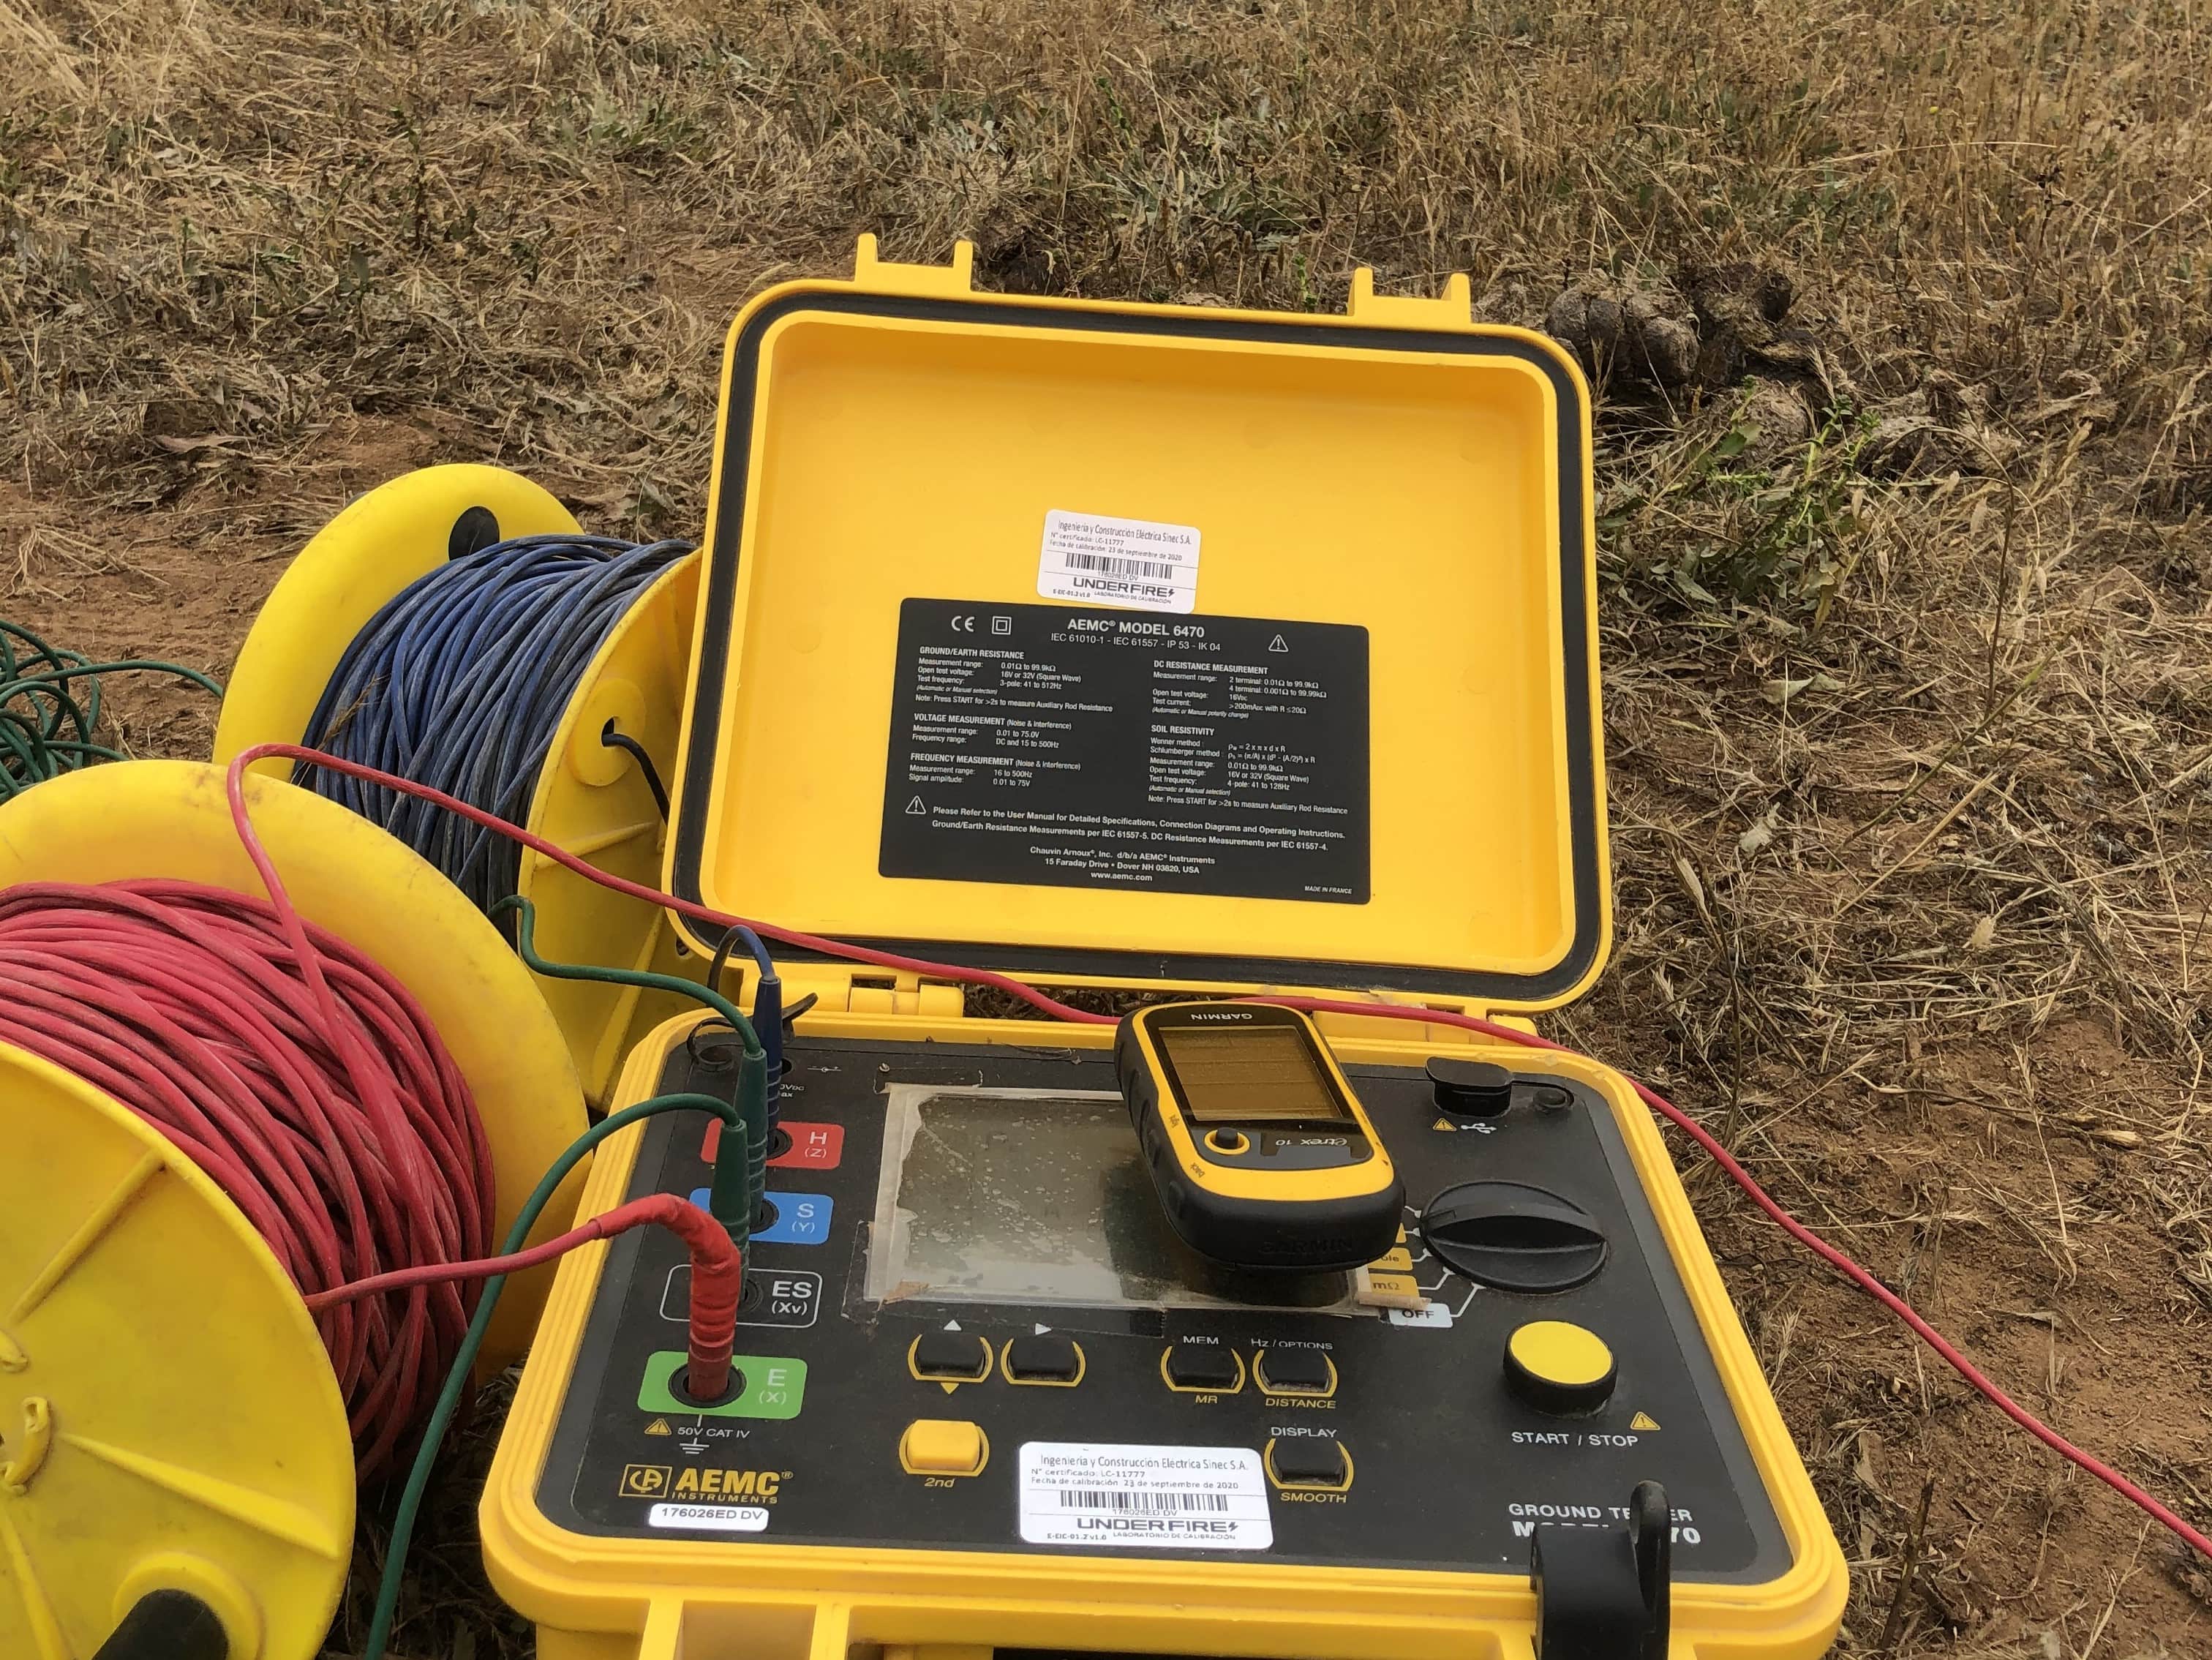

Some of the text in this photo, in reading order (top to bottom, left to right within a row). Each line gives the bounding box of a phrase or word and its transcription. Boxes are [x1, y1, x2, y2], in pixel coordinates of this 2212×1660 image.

[1119, 622, 1170, 636] MODEL
[1173, 625, 1204, 638] 6470
[1051, 633, 1220, 651] IEC 61010-1 IEC 61557 IP 53 IK 04
[919, 646, 1024, 659] GROUND/EARTH RESISTANCE
[1166, 661, 1211, 671] RESISTANCE
[1213, 664, 1268, 675] MEASUREMENT
[914, 713, 947, 722] VOLTAGE
[948, 715, 1005, 725] MEASUREMENT
[1007, 719, 1026, 727] (Noise
[1034, 721, 1072, 730] Interference)
[1151, 724, 1214, 736] SOIL RESISTIVITY
[910, 753, 955, 762] FREQUENCY
[957, 755, 1014, 765] MEASUREMENT
[1015, 759, 1034, 767] (Noise
[1042, 761, 1080, 771] Interference)
[933, 806, 958, 815] Please
[960, 808, 982, 816] Refer
[993, 810, 1005, 818] the
[1007, 811, 1026, 819] User
[1027, 811, 1055, 820] Manual
[1069, 814, 1100, 823] Detailed
[1102, 816, 1157, 827] Specifications,
[1159, 819, 1203, 830] Connection
[1205, 822, 1241, 833] Diagrams
[1259, 825, 1296, 837] Operating
[1298, 828, 1345, 838] Instructions.
[932, 819, 983, 830] Ground/Earth
[985, 822, 1028, 833] Resistance
[1029, 825, 1086, 835] Measurements
[1102, 830, 1116, 838] IEC
[1117, 830, 1148, 840] 61557-5.
[1165, 833, 1207, 843] Resistance
[1208, 835, 1265, 846] Measurements
[1281, 841, 1295, 849] IEC
[1296, 841, 1328, 850] 61557-4.
[1030, 846, 1061, 855] Chauvin
[1169, 855, 1215, 864] Instruments
[1056, 858, 1087, 868] Faraday
[1088, 860, 1109, 868] Drive
[1117, 862, 1140, 870] Dover
[1156, 864, 1181, 874] 03820,
[1182, 865, 1200, 874] USA
[1091, 872, 1153, 881] www.aemc.com
[809, 1132, 827, 1146] H
[805, 1147, 827, 1159] (Z)
[797, 1203, 814, 1218] S
[791, 1220, 816, 1233] (Y)
[772, 1281, 812, 1298] ES
[772, 1301, 808, 1315] (Xv)
[1402, 1308, 1434, 1318] OFF
[1183, 1336, 1219, 1345] MEM
[1251, 1338, 1268, 1347] Hz
[1279, 1341, 1333, 1350] OPTIONS
[768, 1369, 787, 1386] E
[759, 1391, 787, 1405] (X)
[1195, 1394, 1217, 1403] MR
[1265, 1398, 1336, 1409] DISTANCE
[677, 1427, 750, 1438] 50V CAT IV
[1271, 1427, 1337, 1438] DISPLAY
[1511, 1432, 1638, 1446] START / STOP
[925, 1477, 955, 1488] 2nd
[672, 1492, 778, 1503] INSTRUMENTS
[1280, 1492, 1347, 1503] SMOOTH
[662, 1507, 767, 1520] 176026ED DV
[1508, 1503, 1693, 1522] GROUND TEER
